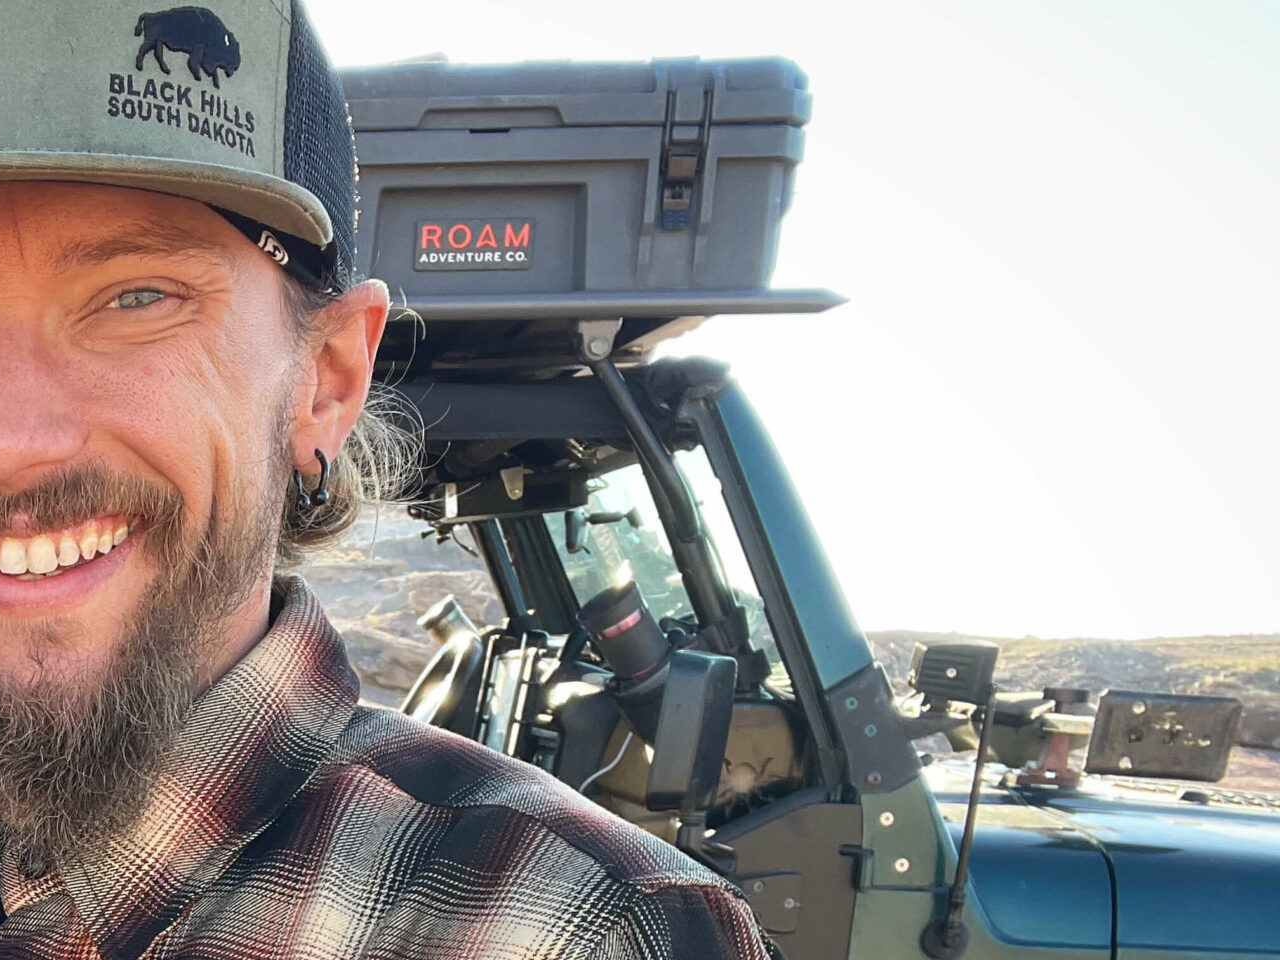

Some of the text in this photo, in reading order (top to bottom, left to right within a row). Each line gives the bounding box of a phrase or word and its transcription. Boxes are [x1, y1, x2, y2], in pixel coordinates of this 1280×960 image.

[109, 73, 256, 133] BLACK HILLS
[107, 96, 256, 158] SOUTH DAKOTA
[419, 251, 528, 264] ADVENTURE CO.
[421, 223, 531, 249] ROAM
